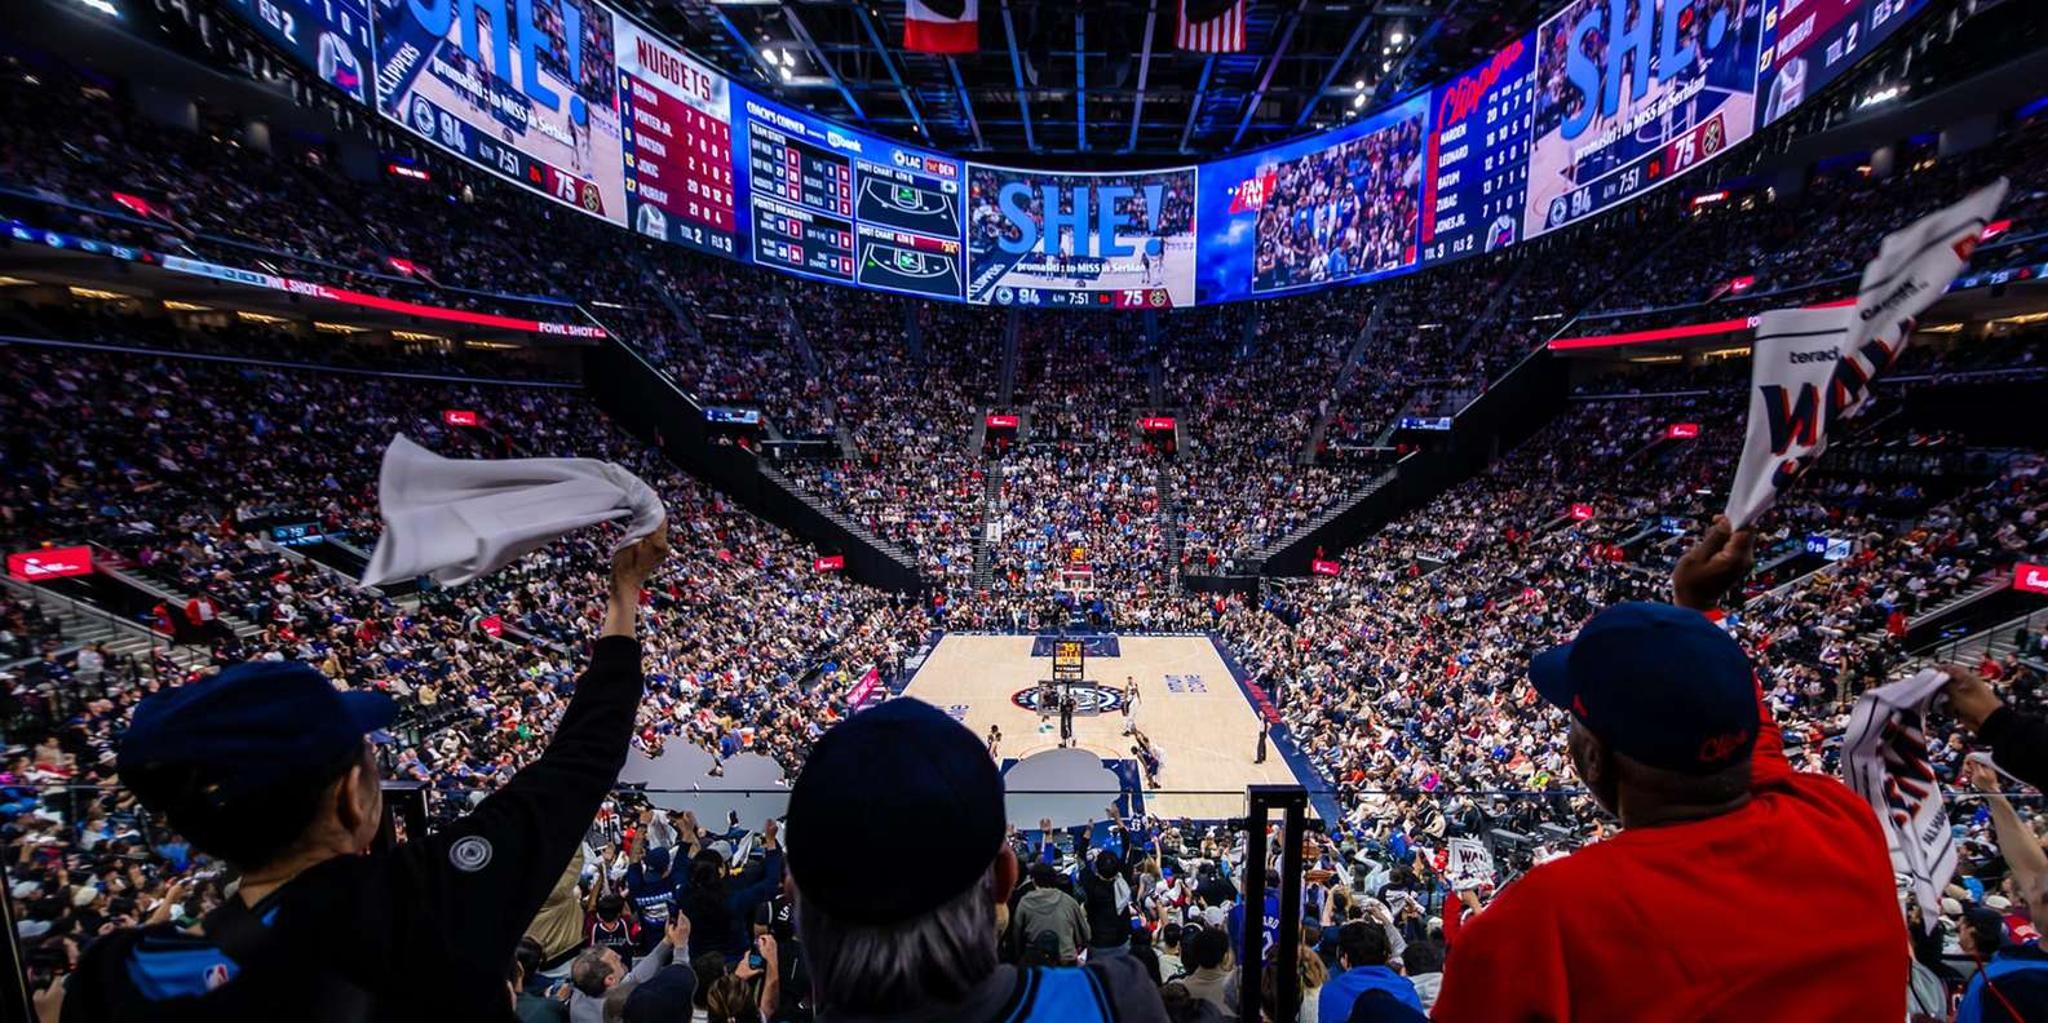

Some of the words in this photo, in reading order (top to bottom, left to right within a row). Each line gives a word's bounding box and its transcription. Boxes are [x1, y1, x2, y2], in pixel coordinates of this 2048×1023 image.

[1845, 21, 1859, 54] 2
[377, 43, 420, 95] CLIPPERS
[636, 36, 710, 101] NUGGETS
[503, 96, 527, 122] MISS
[1514, 94, 1520, 110] 7
[1634, 106, 1657, 132] MISS
[1668, 75, 1706, 108] Serbian
[440, 112, 466, 153] 94
[497, 147, 520, 176] 7:51
[554, 171, 576, 203] 75
[905, 156, 921, 168] LAC
[939, 164, 955, 177] DEN
[1497, 175, 1503, 189] 7
[1571, 186, 1592, 217] 94
[1619, 167, 1640, 195] 7:51
[1674, 132, 1696, 172] 75
[1242, 178, 1263, 196] FAN
[998, 182, 1165, 258] SHE!
[1483, 204, 1489, 218] 7
[695, 228, 702, 244] 2
[725, 237, 732, 253] 3
[1437, 242, 1445, 258] 3
[1466, 234, 1474, 250] 2
[1067, 263, 1076, 272] to
[1078, 263, 1100, 272] MISS
[289, 280, 320, 298] SHOT
[1019, 288, 1040, 305] 94
[1069, 292, 1088, 305] 7:51
[1124, 290, 1143, 306] 75
[539, 322, 567, 335] FOWL
[569, 325, 593, 338] SHOT
